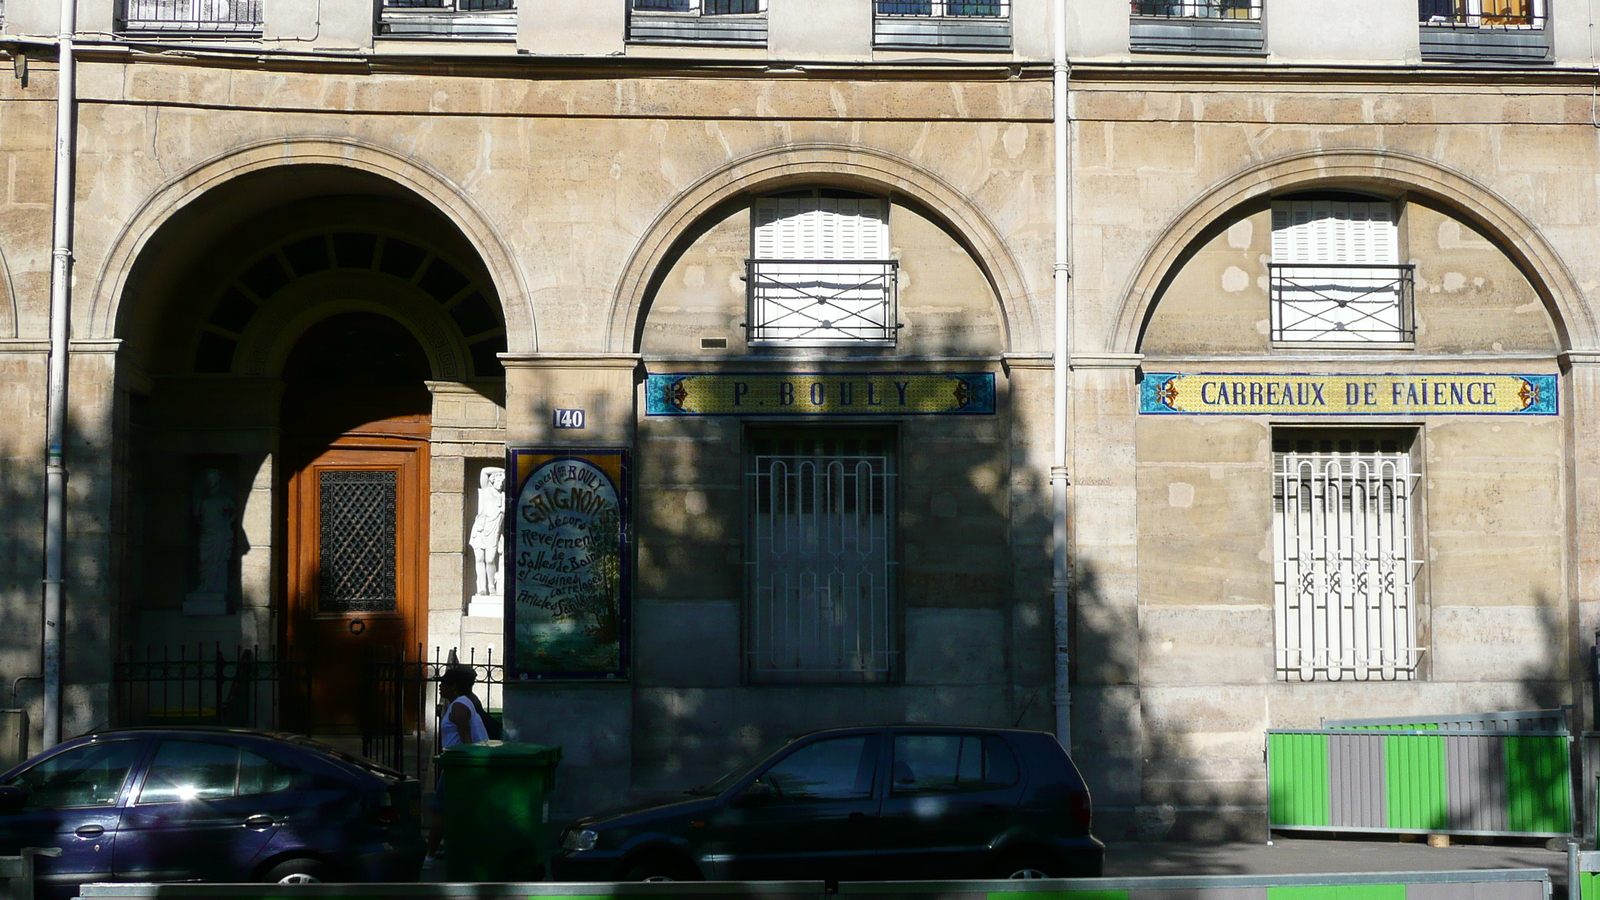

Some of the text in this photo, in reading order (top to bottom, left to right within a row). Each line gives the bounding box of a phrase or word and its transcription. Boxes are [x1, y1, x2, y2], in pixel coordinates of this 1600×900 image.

[779, 382, 909, 406] BOULY
[1200, 378, 1497, 406] CARREAUX DE FAÏENCE
[554, 408, 583, 428] 140
[564, 465, 605, 494] BOULY
[517, 550, 603, 573] Salles de Bains
[552, 549, 565, 560] de
